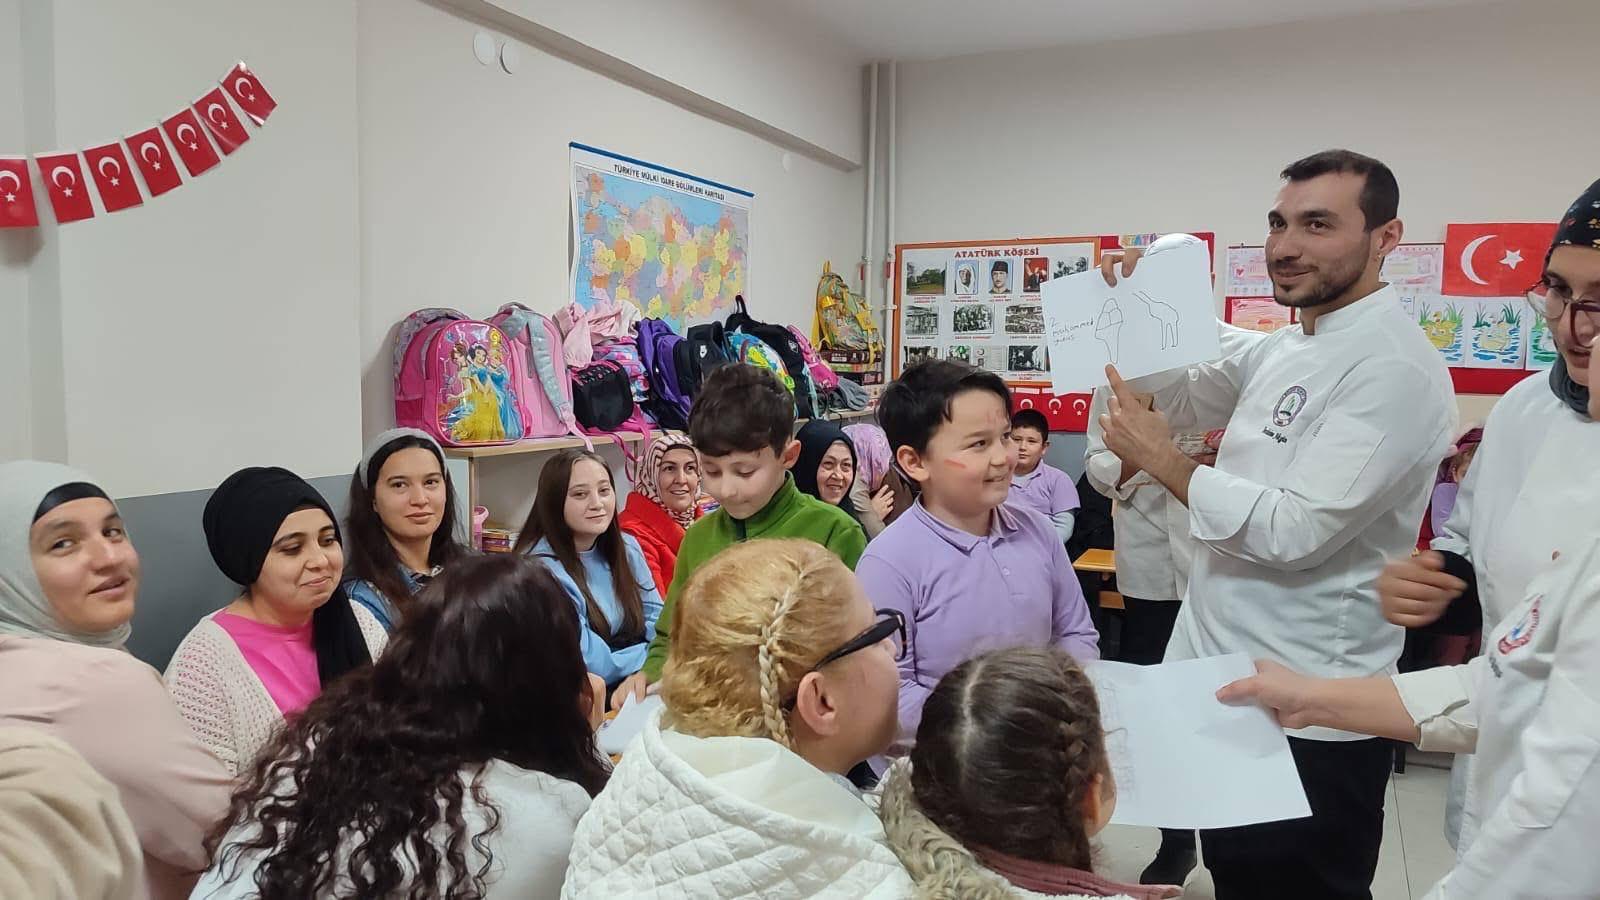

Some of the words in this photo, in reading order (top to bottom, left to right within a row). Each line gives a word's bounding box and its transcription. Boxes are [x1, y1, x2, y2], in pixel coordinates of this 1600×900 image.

[614, 164, 640, 177] TÜRKİYE
[954, 248, 1001, 258] ATATÜRK
[1003, 247, 1040, 257] KÖŞESİ
